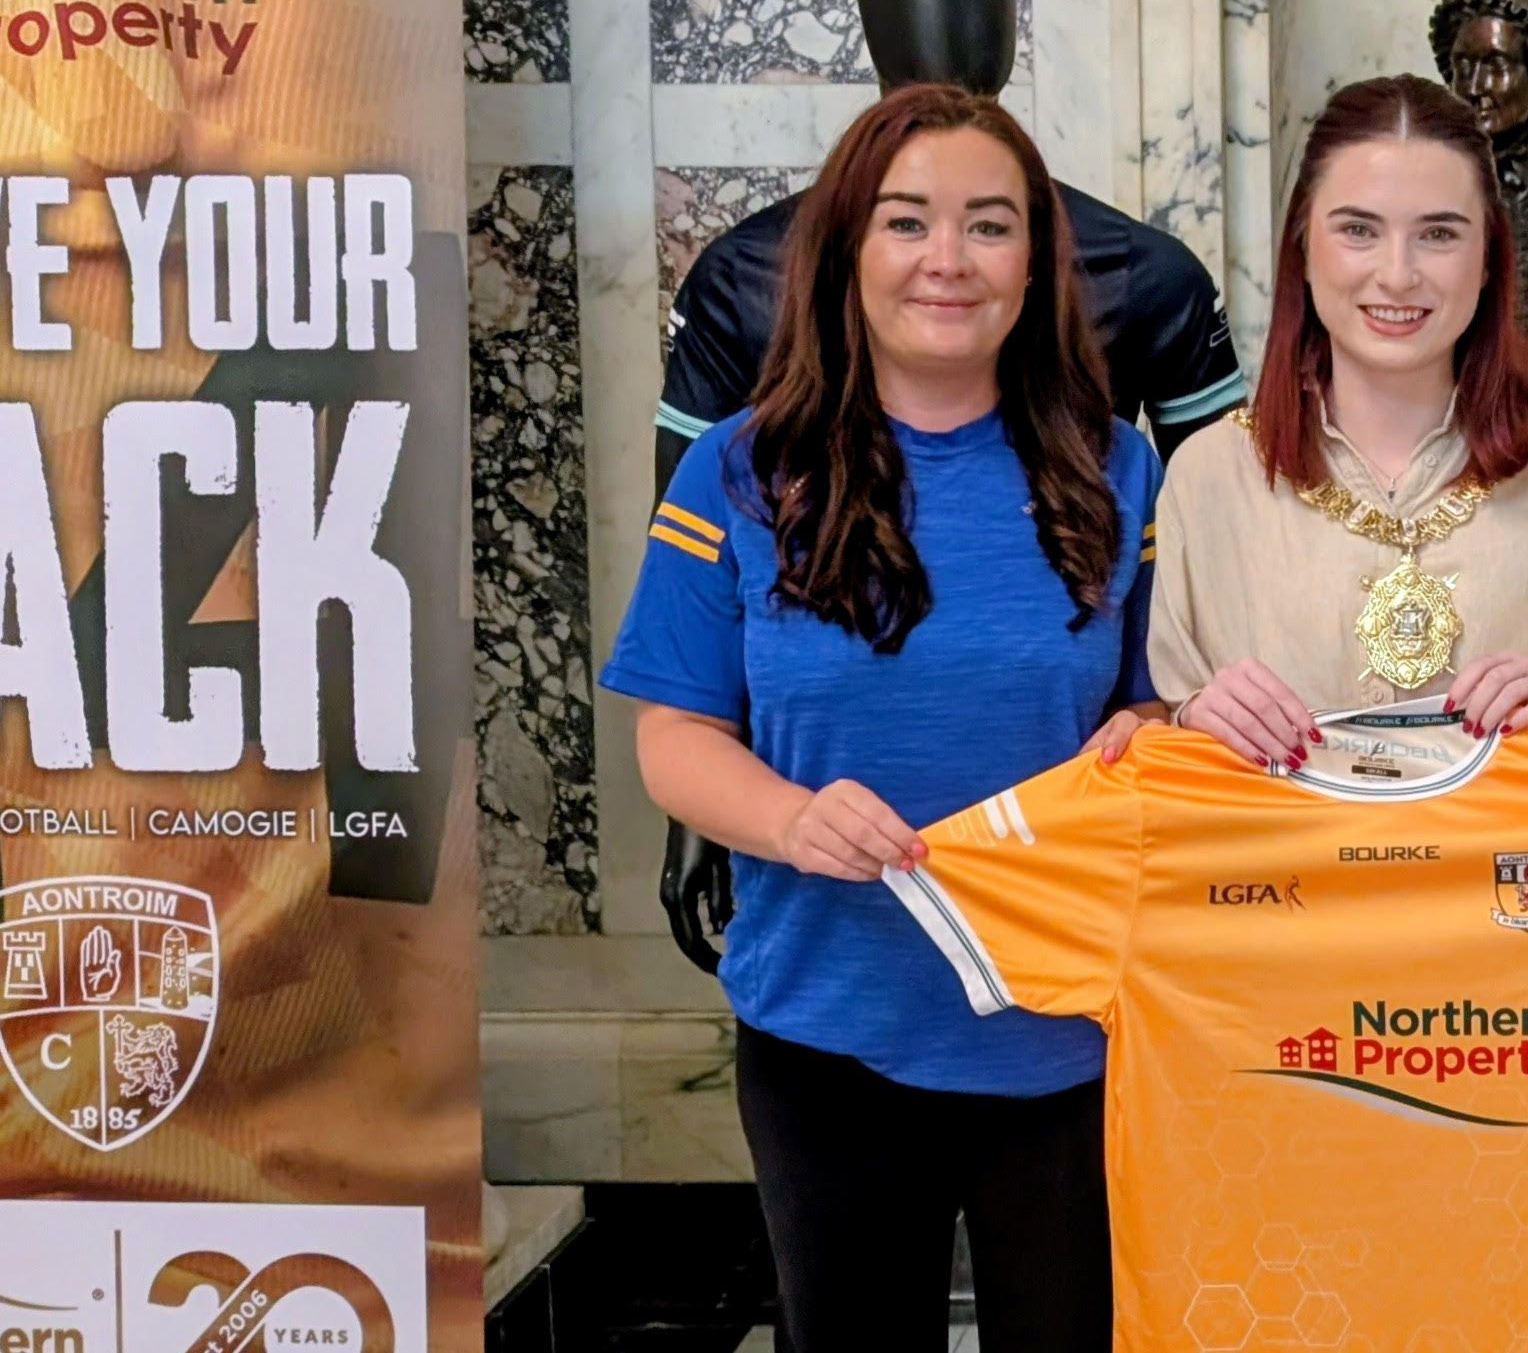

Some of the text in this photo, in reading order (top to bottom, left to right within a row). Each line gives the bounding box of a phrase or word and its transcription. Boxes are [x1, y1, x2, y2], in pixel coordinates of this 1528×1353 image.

[0, 0, 259, 76] operty
[0, 173, 418, 351] E YOUR
[0, 808, 408, 837] OTBALL CAMOGIE LGFA
[1338, 845, 1441, 862] BOURKE
[21, 887, 179, 917] AONTROIM
[1209, 883, 1282, 906] LGFA
[40, 1033, 73, 1070] C
[217, 1288, 269, 1344] 2006
[274, 1327, 350, 1345] YEARS
